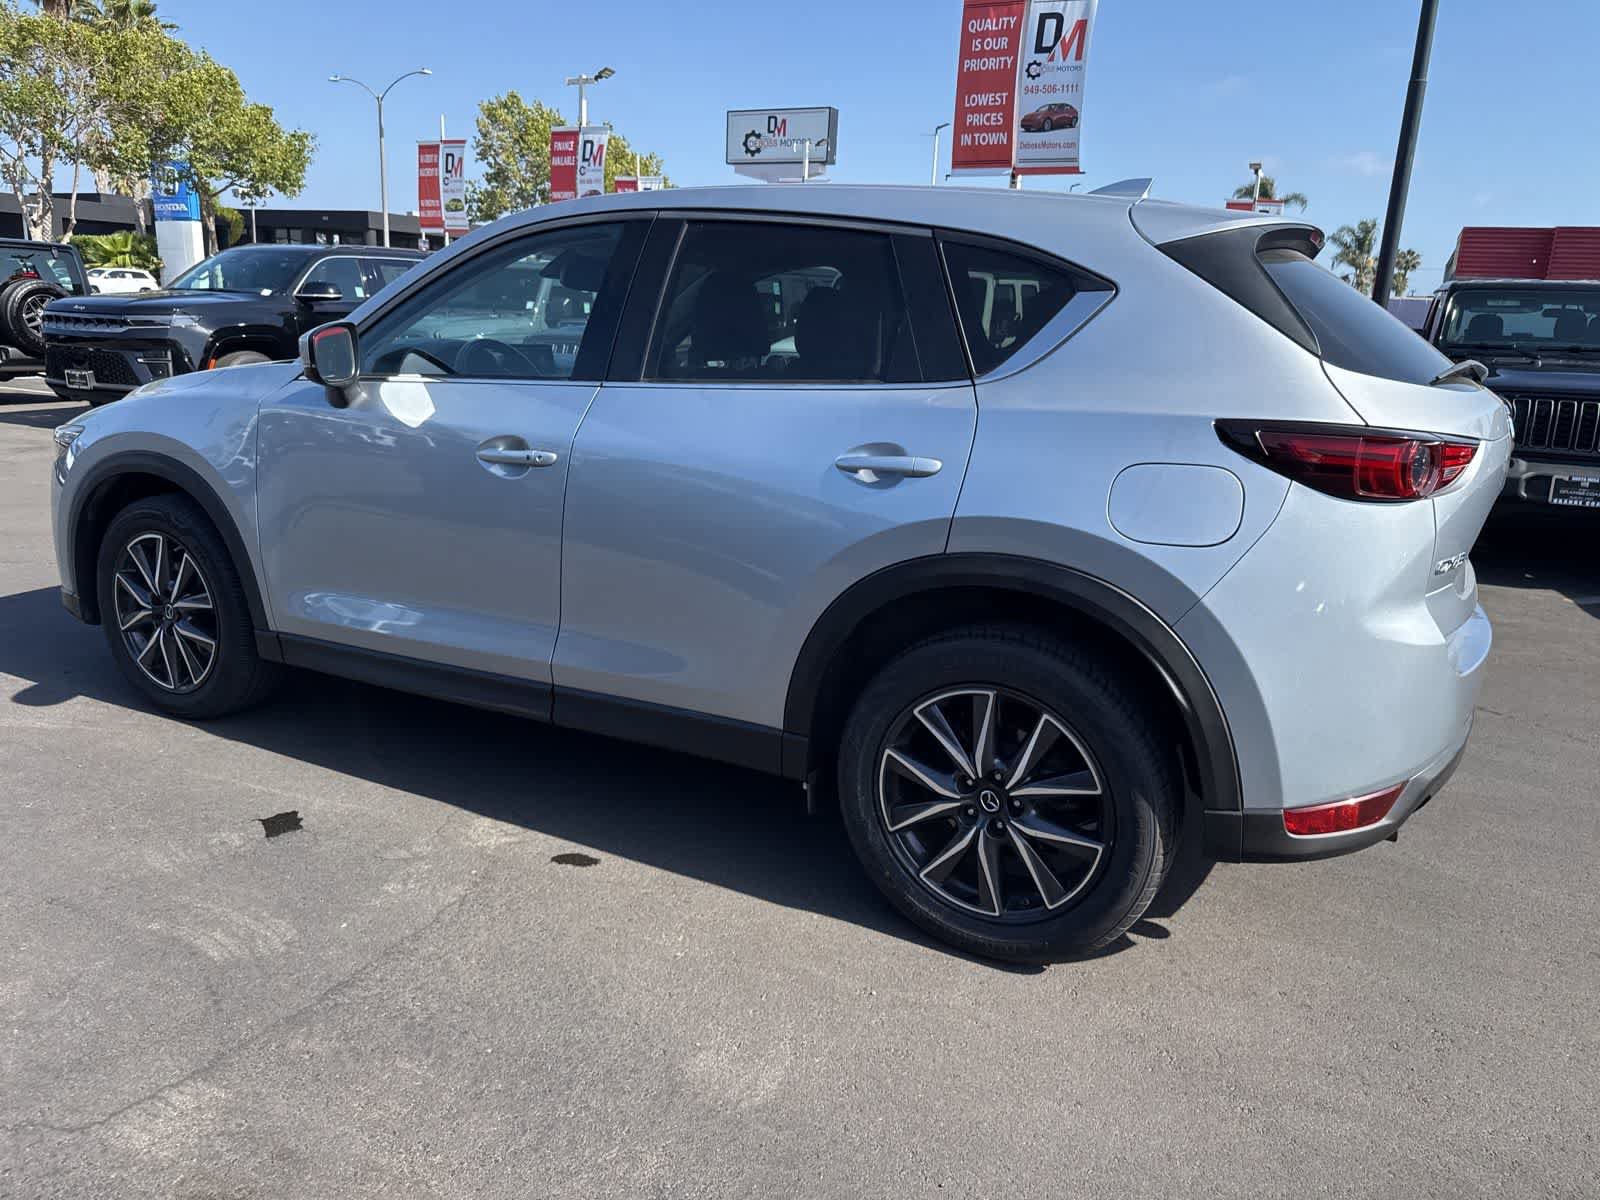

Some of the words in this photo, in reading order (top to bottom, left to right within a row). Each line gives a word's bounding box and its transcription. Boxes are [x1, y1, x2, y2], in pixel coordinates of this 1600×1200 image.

[969, 16, 1017, 33] QUALITY
[972, 40, 981, 52] IS
[984, 37, 1008, 51] OUR
[964, 56, 1014, 73] PRIORITY
[1056, 65, 1083, 73] MOTORS
[1024, 83, 1079, 95] 949-506-1111
[965, 93, 1008, 108] LOWEST
[966, 113, 1004, 127] PRICES
[960, 134, 972, 146] IN
[974, 132, 1008, 146] TOWN
